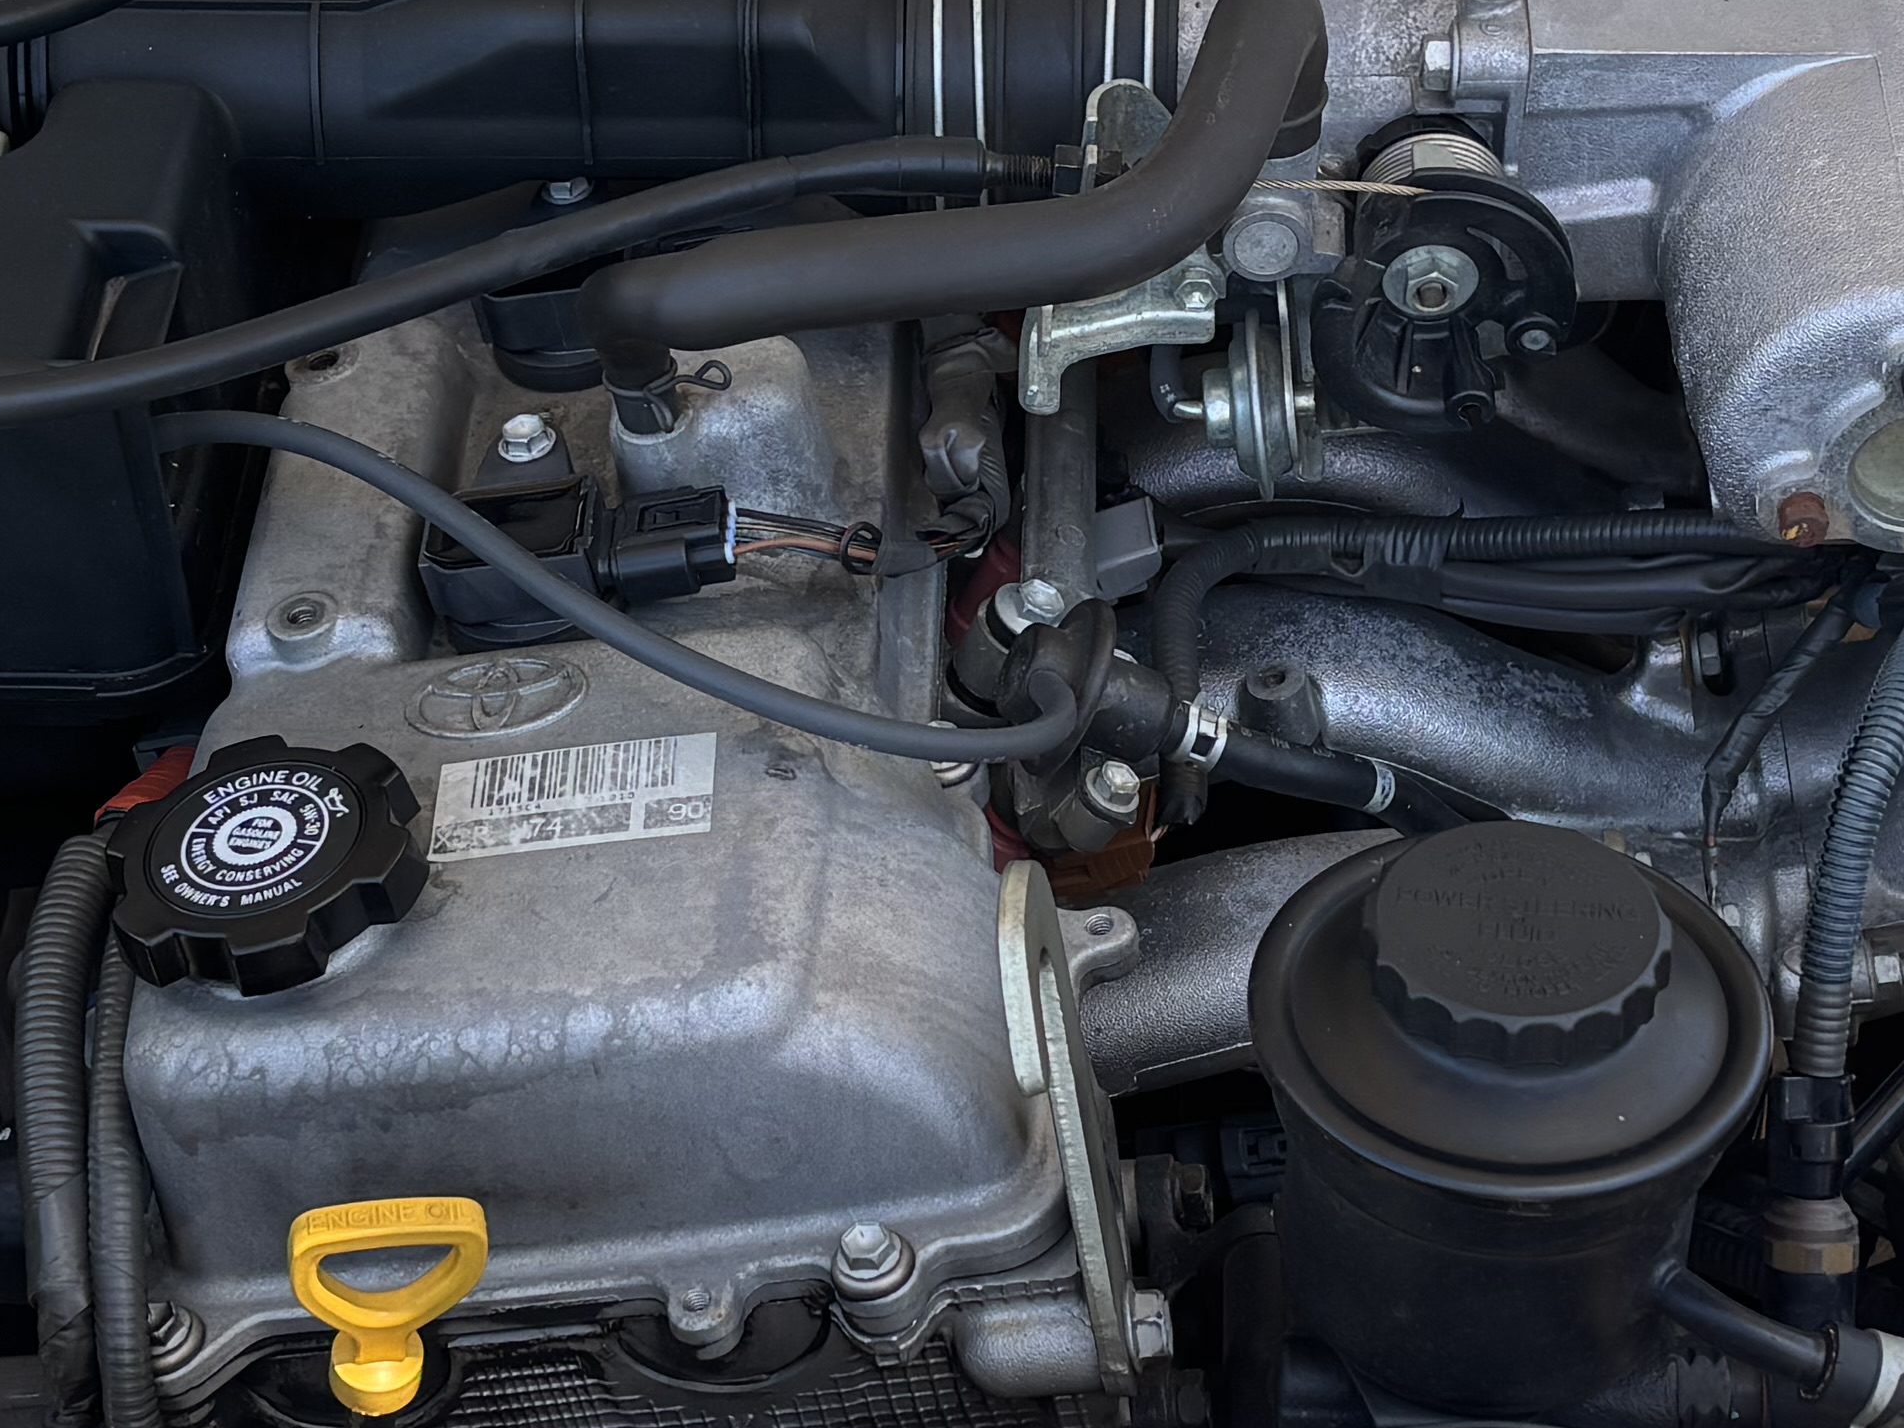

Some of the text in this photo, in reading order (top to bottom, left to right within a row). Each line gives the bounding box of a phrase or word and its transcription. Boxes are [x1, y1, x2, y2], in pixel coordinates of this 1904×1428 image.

[202, 769, 324, 805] ENGINE OIL
[207, 790, 320, 836] API SJ SAE 5W-30
[192, 837, 305, 883] ENERGY CONSERVING
[160, 863, 303, 908] SEE OWNER'S MANUAL
[306, 1202, 473, 1236] ENGINE OIL
